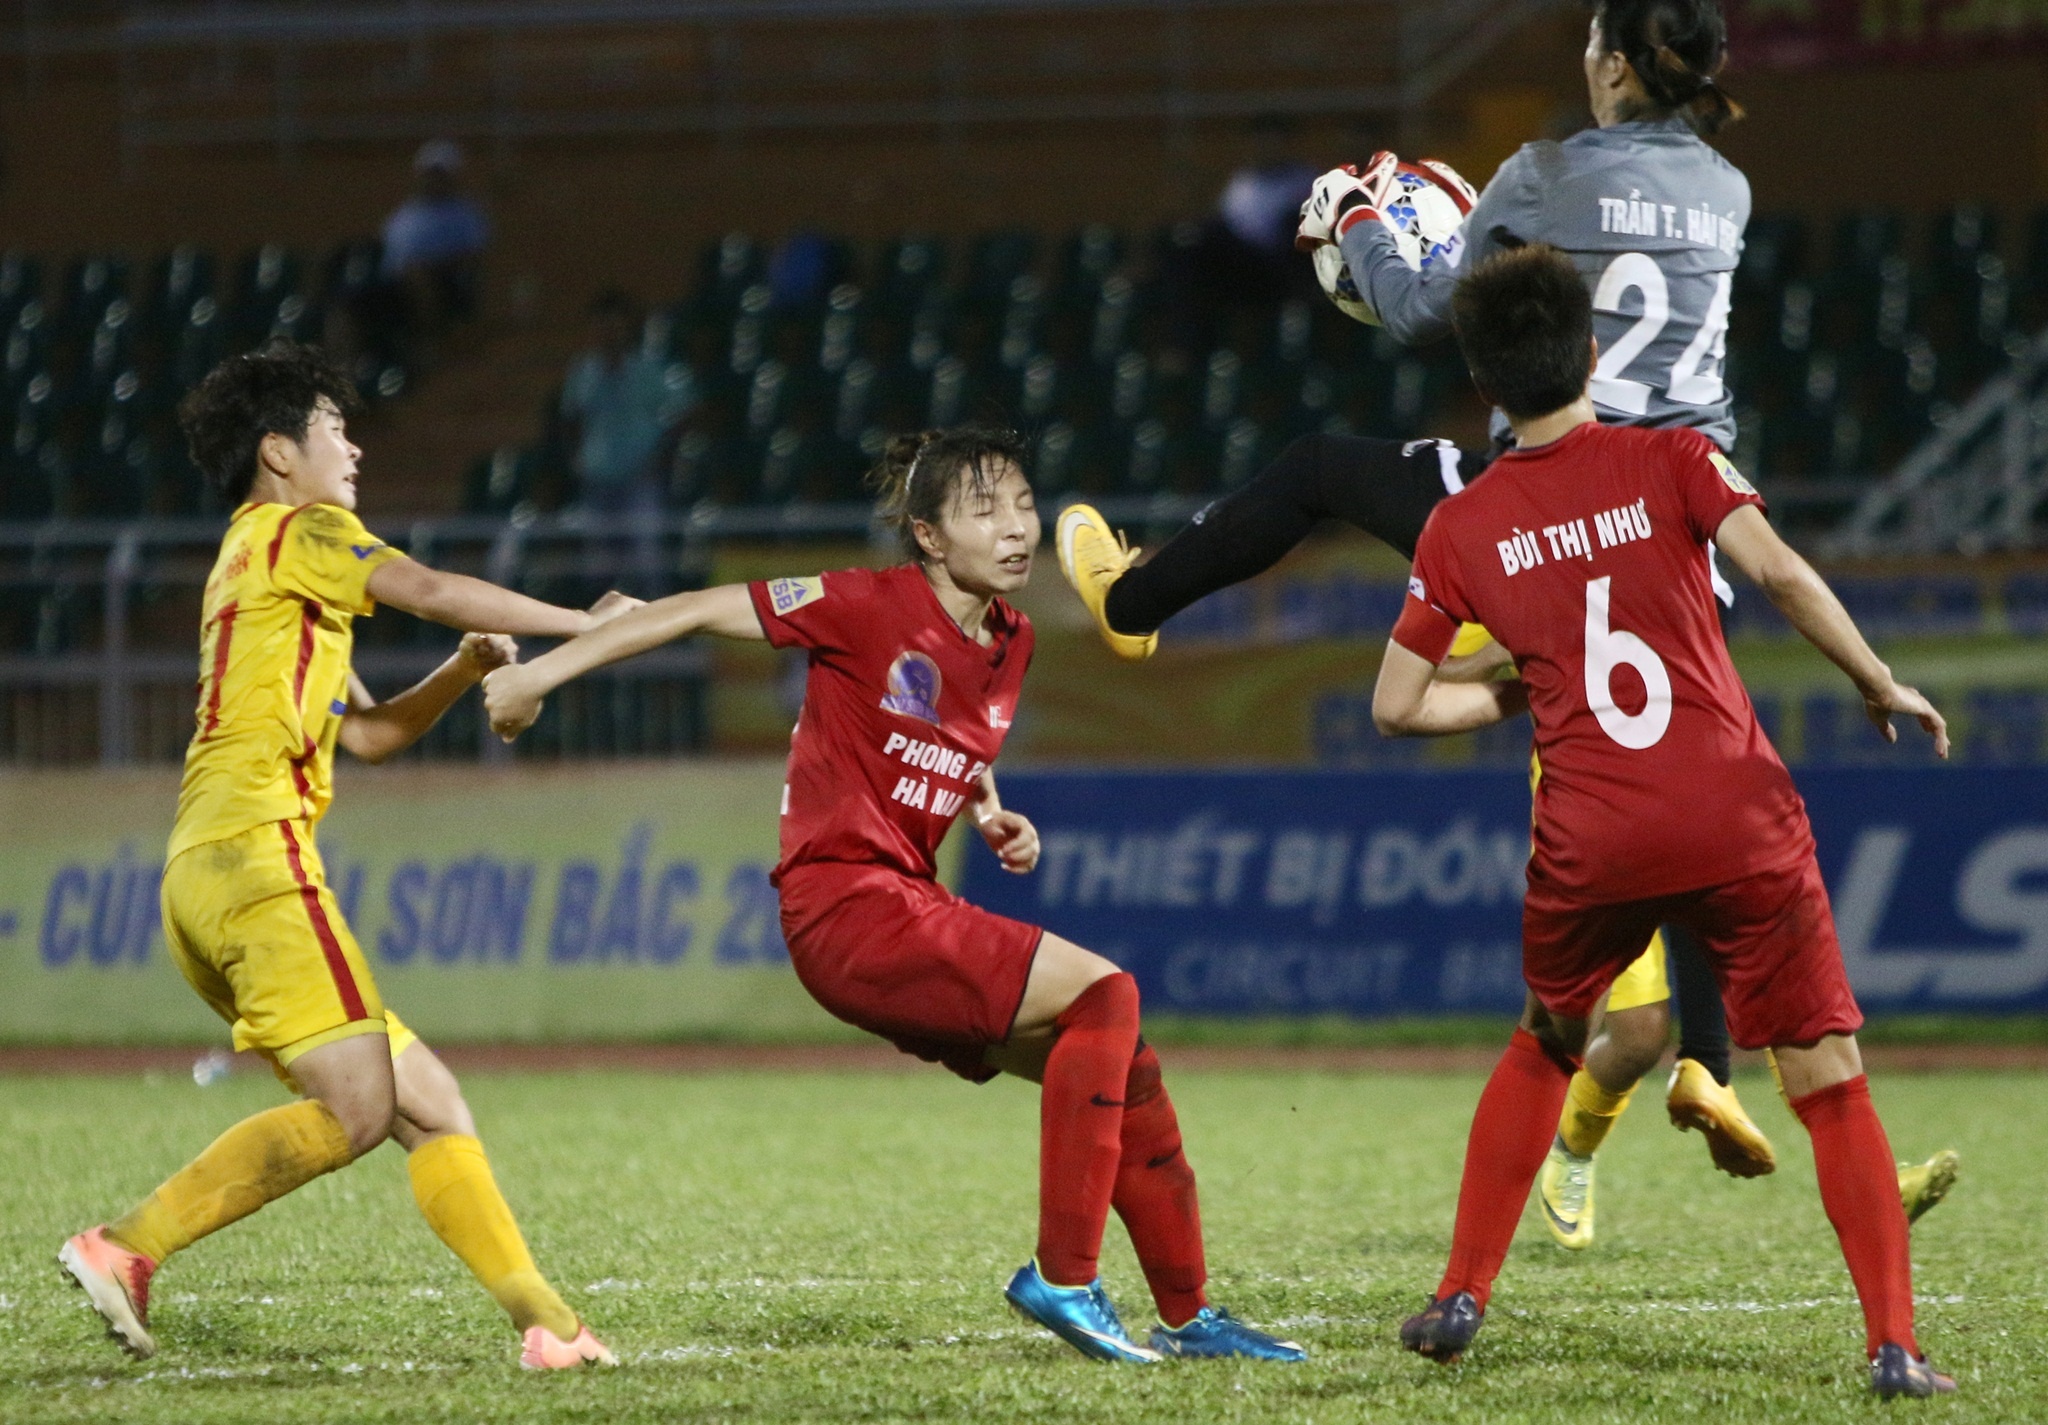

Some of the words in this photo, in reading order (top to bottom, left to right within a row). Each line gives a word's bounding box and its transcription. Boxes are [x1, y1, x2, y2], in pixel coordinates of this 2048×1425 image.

[1660, 204, 1683, 239] T.
[1496, 527, 1544, 577] BÙI
[1543, 518, 1593, 561] THỊ
[1594, 497, 1652, 549] NHƯ
[1584, 576, 1673, 750] 6
[883, 731, 967, 780] PHONG
[964, 760, 987, 784] P
[891, 776, 929, 811] HÀ
[1038, 809, 1261, 908] THIẾT
[1263, 826, 1354, 926] BỊ
[1360, 813, 1530, 906] ĐÓN
[377, 853, 535, 966] SƠN
